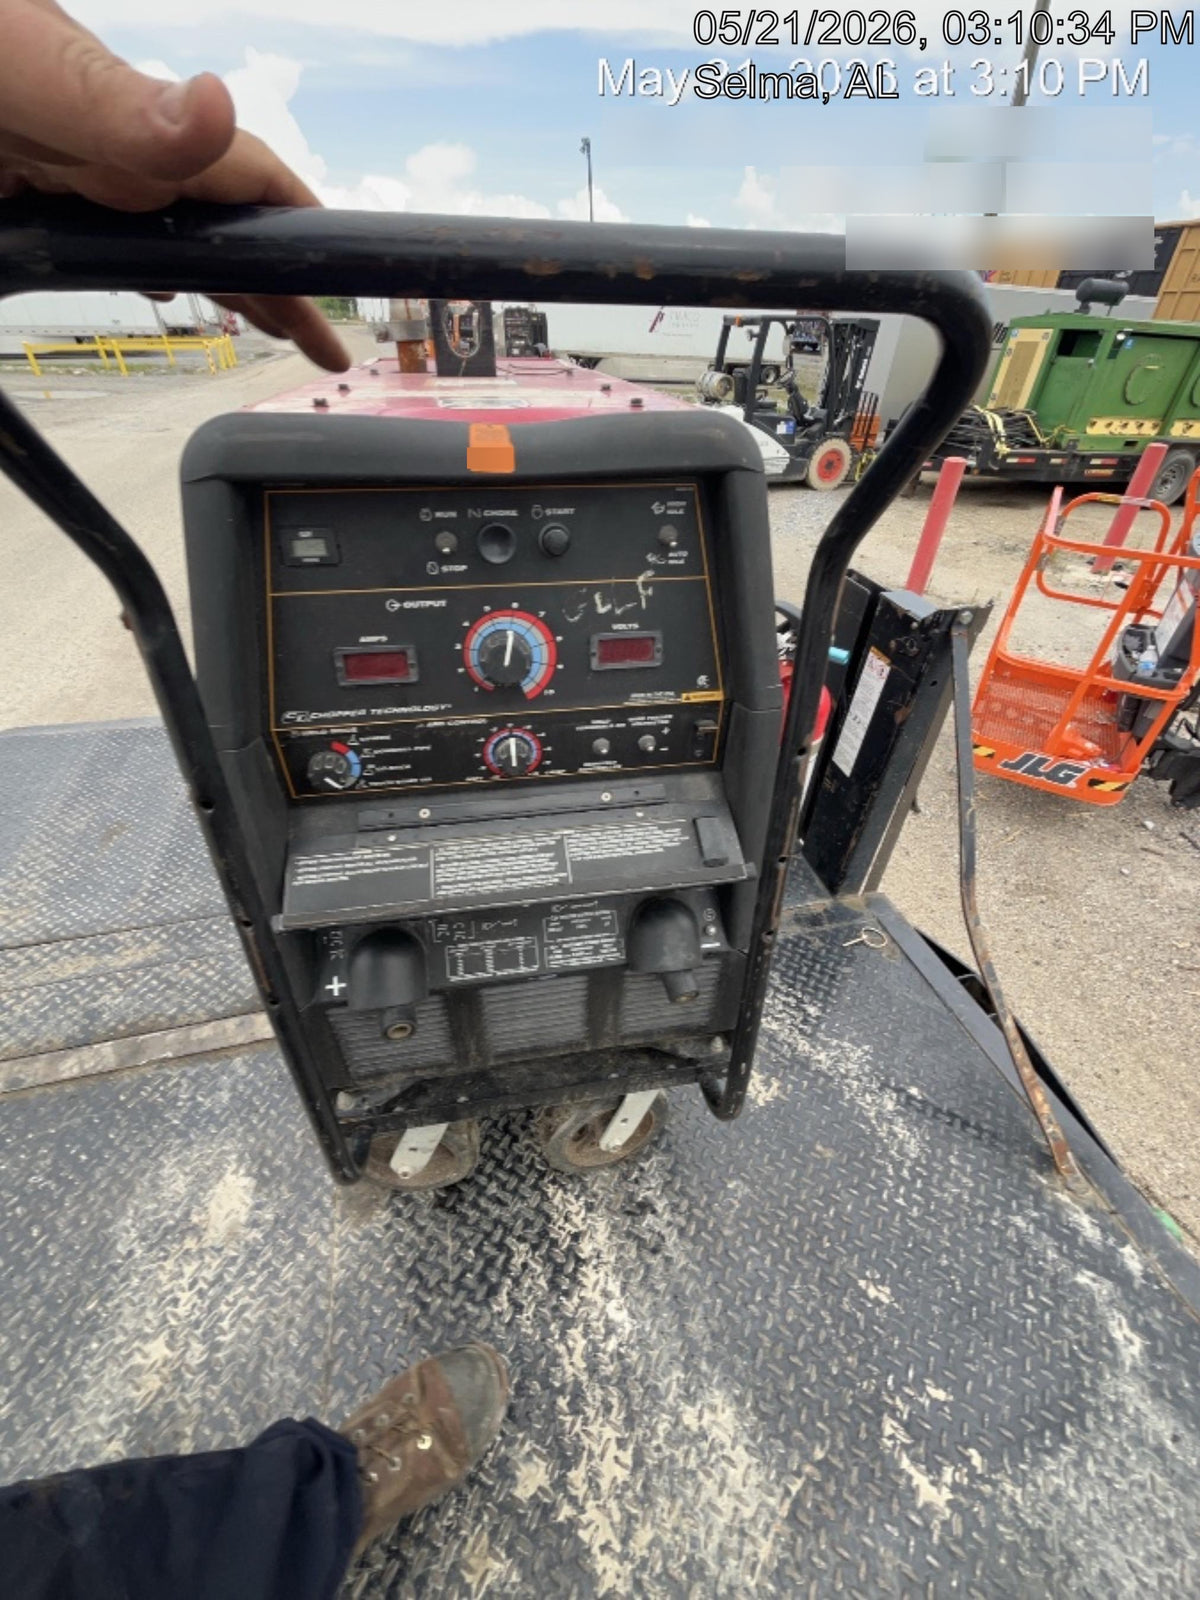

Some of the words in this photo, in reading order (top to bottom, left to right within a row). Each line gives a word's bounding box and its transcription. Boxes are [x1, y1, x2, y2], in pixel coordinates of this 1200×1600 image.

[483, 509, 519, 517] CHOKE
[440, 564, 469, 573] STOP
[402, 599, 448, 609] OUTPUT
[309, 708, 367, 720] CHOPPER
[369, 703, 449, 716] TECHNOLOGY
[997, 752, 1088, 787] JLG
